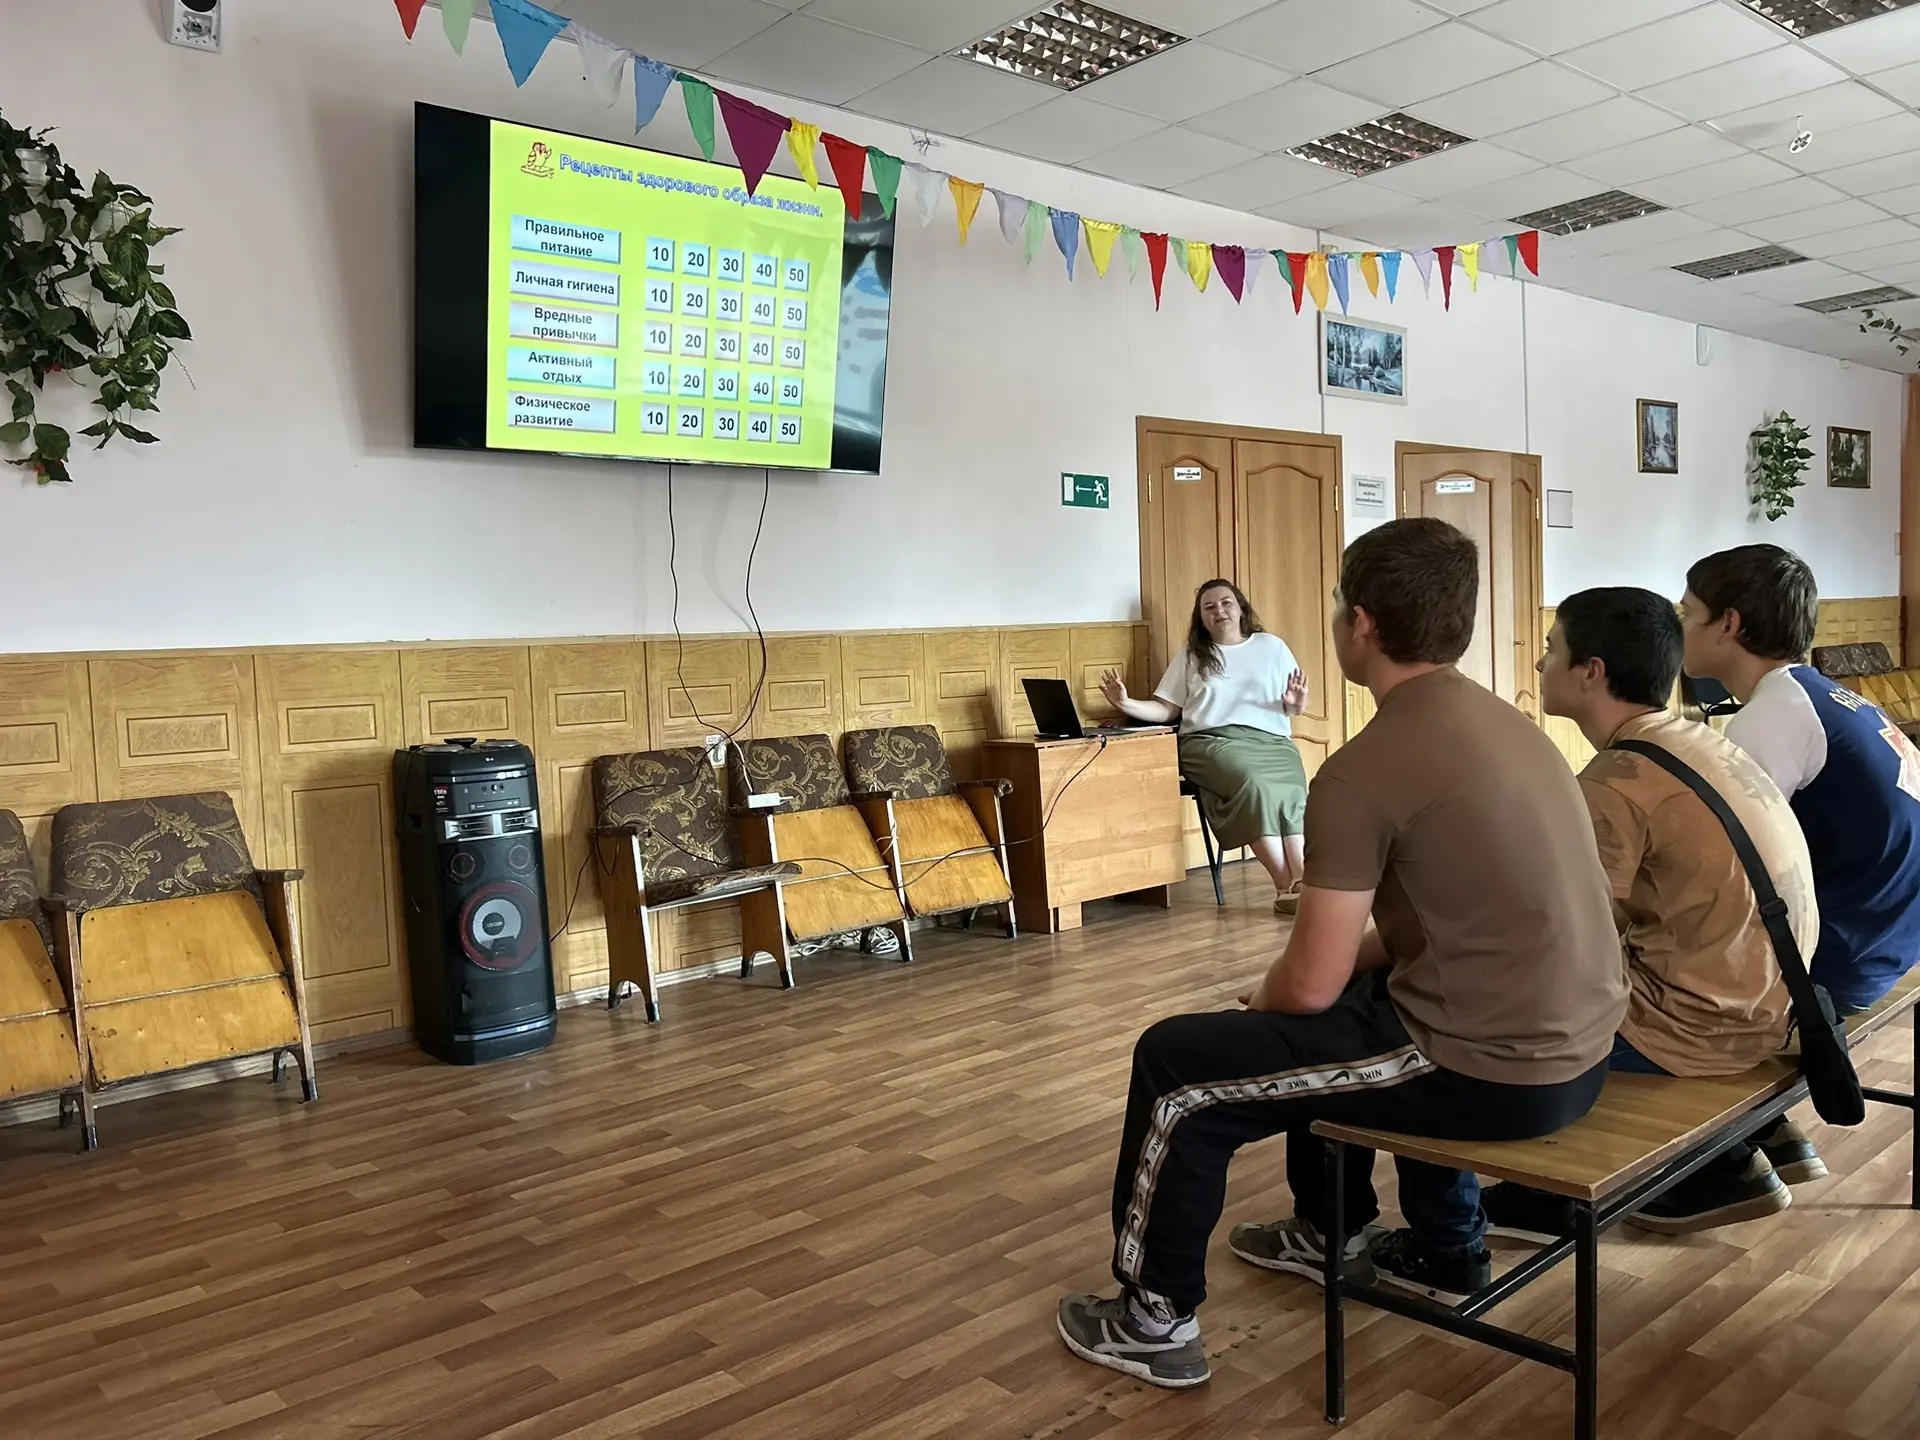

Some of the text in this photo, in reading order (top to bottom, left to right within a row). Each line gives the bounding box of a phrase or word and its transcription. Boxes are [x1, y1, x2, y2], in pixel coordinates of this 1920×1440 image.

[560, 154, 824, 217] Рецепты здорового образа жизни.
[525, 219, 605, 242] Правильное
[541, 241, 593, 257] питание
[652, 246, 669, 262] 10
[687, 251, 705, 267] 20
[722, 257, 739, 272] 30
[756, 263, 772, 277] 40
[789, 268, 804, 282] 50
[515, 271, 615, 295] Личная гигиена
[651, 288, 667, 303] 10
[686, 293, 703, 308] 20
[721, 298, 737, 312] 30
[754, 302, 770, 317] 40
[534, 307, 593, 324] Вредные
[787, 307, 802, 321] 50
[533, 326, 597, 342] привычки
[650, 329, 666, 344] 10
[685, 333, 701, 348] 20
[719, 338, 736, 352] 30
[752, 342, 769, 356] 40
[528, 351, 593, 368] Активный
[785, 346, 800, 360] 50
[542, 371, 582, 384] отдых
[648, 370, 665, 385] 10
[683, 374, 700, 388] 20
[718, 377, 734, 392] 30
[753, 381, 769, 395] 40
[783, 385, 798, 398] 50
[514, 395, 591, 412] Физическое
[514, 414, 574, 427] развитие
[647, 411, 663, 426] 10
[682, 414, 698, 428] 20
[718, 417, 735, 431] 30
[751, 420, 767, 434] 40
[781, 422, 796, 436] 50
[1359, 1068, 1383, 1082] NIKE
[1287, 1079, 1309, 1090] NIKE
[1223, 1088, 1243, 1098] NIKE
